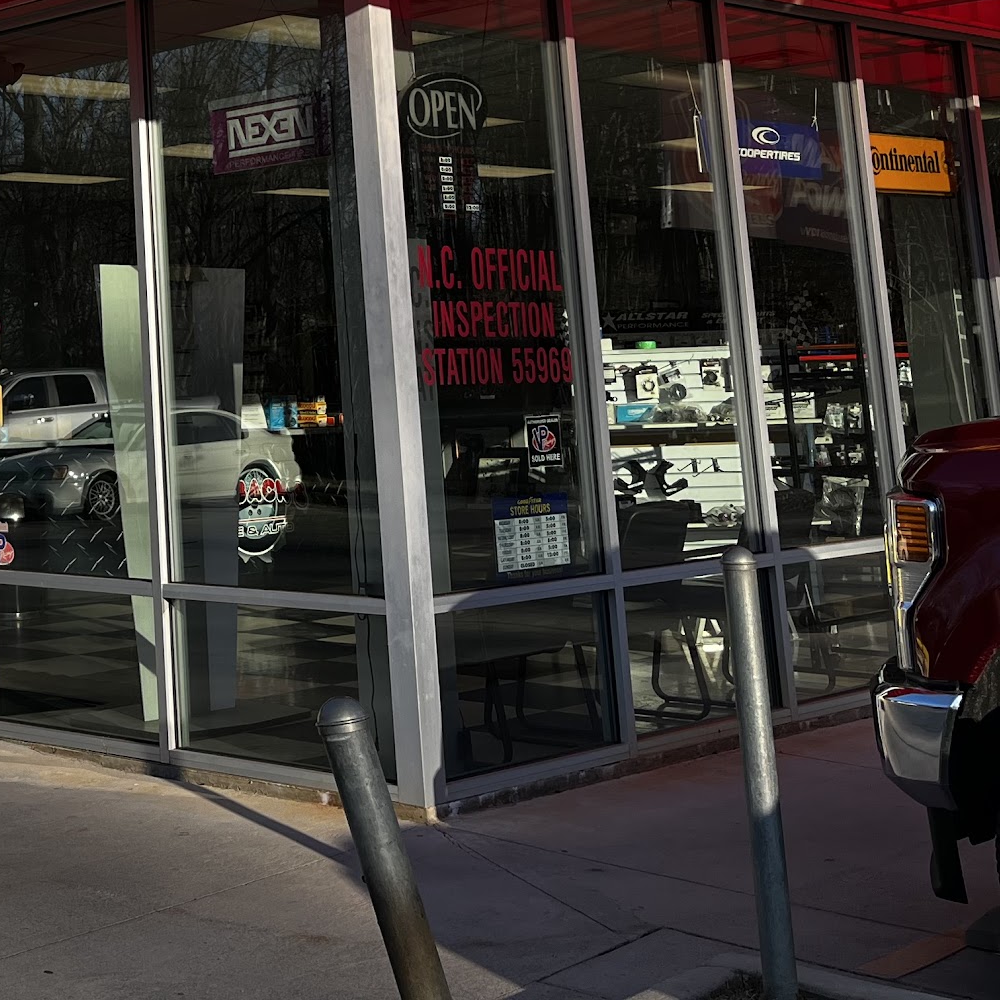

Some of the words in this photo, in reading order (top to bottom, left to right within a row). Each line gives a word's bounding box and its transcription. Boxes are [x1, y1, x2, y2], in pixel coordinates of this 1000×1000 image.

[227, 104, 314, 151] NEXEN
[408, 87, 477, 130] OPEN
[418, 245, 462, 289] N.C.
[471, 247, 563, 291] OFFICIAL
[433, 301, 556, 337] INSPECTION
[422, 347, 503, 386] STATION
[512, 347, 573, 383] 55969
[546, 453, 561, 461] HERE
[510, 505, 529, 516] STORE
[530, 503, 551, 514] HOURS
